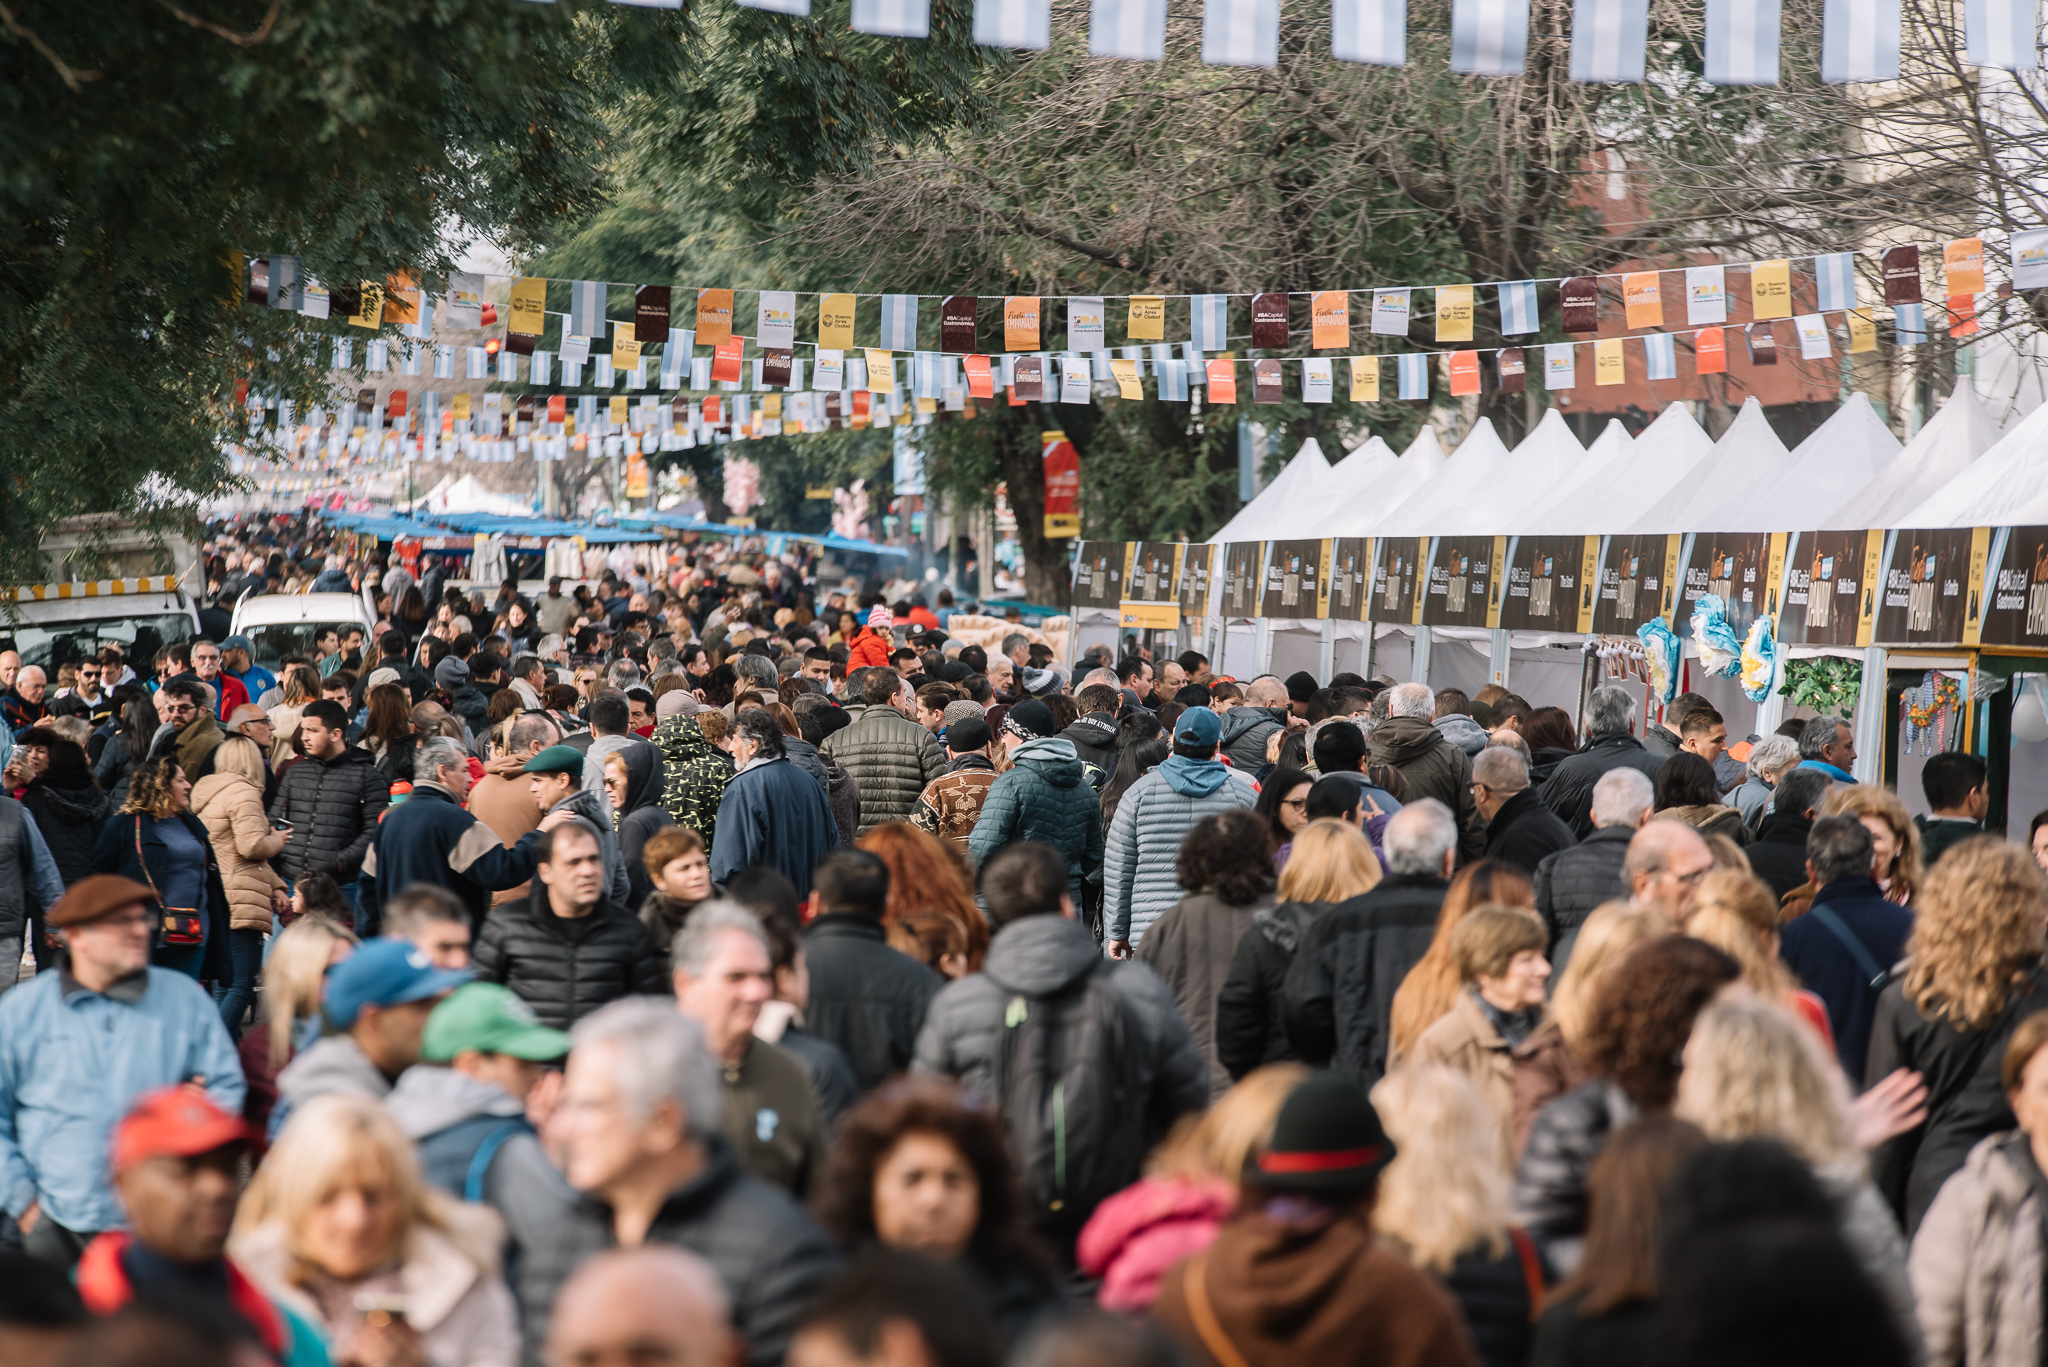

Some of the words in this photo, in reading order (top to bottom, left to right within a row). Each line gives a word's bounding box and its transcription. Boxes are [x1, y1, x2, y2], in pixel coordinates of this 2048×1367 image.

[699, 313, 730, 324] EMPANADA
[1007, 319, 1038, 329] EMPANADA
[1315, 315, 1347, 326] EMPANADA
[1998, 569, 2028, 590] #BACapital
[1996, 592, 2024, 610] Gastronómica
